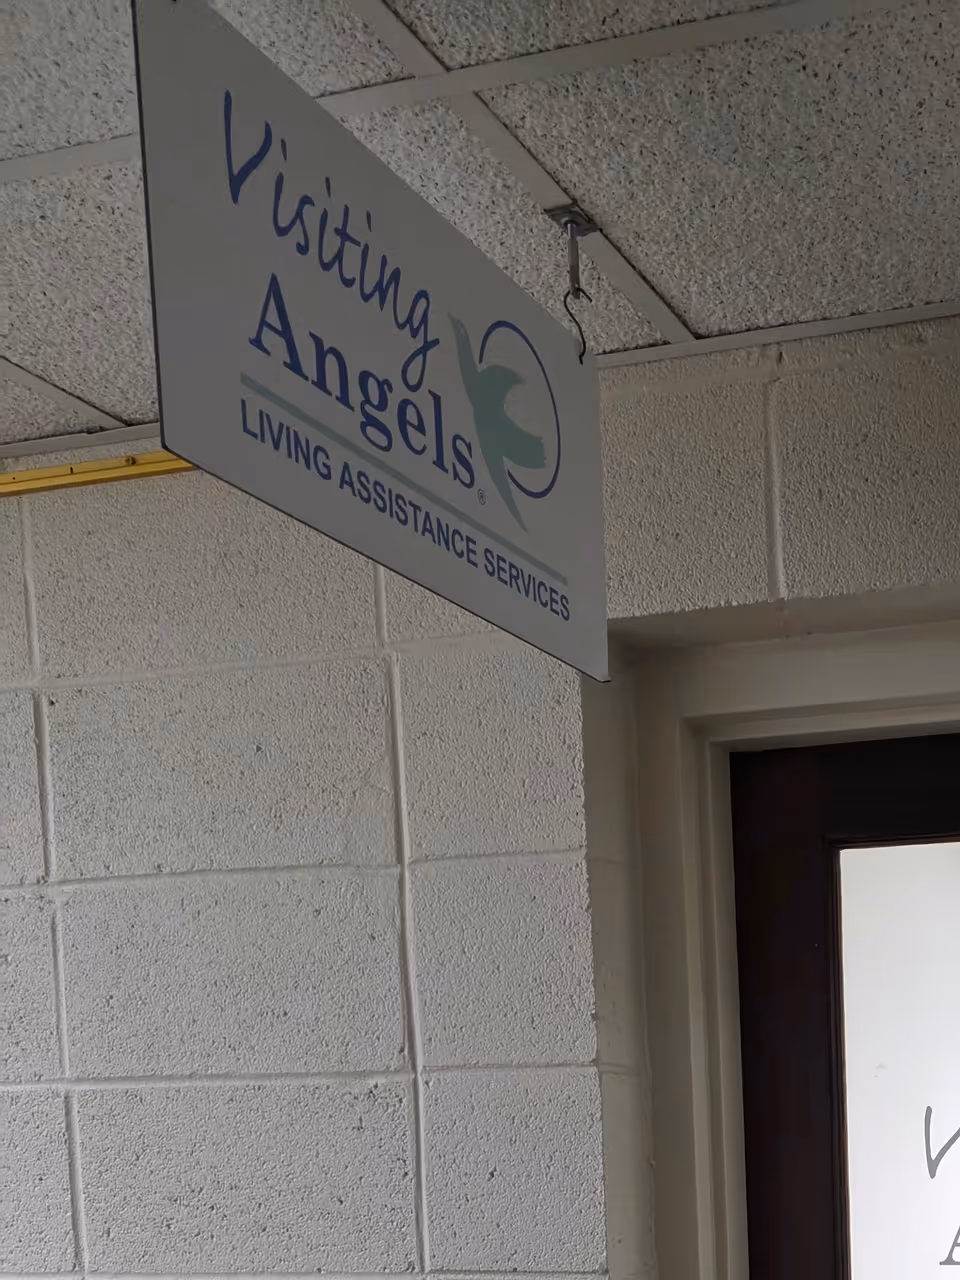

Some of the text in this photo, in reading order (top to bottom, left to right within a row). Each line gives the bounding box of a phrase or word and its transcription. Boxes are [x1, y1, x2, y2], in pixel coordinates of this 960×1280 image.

[223, 89, 440, 389] Visiting
[249, 273, 477, 489] Angels
[241, 398, 571, 622] LIVING ASSISTANCE SERVICES
